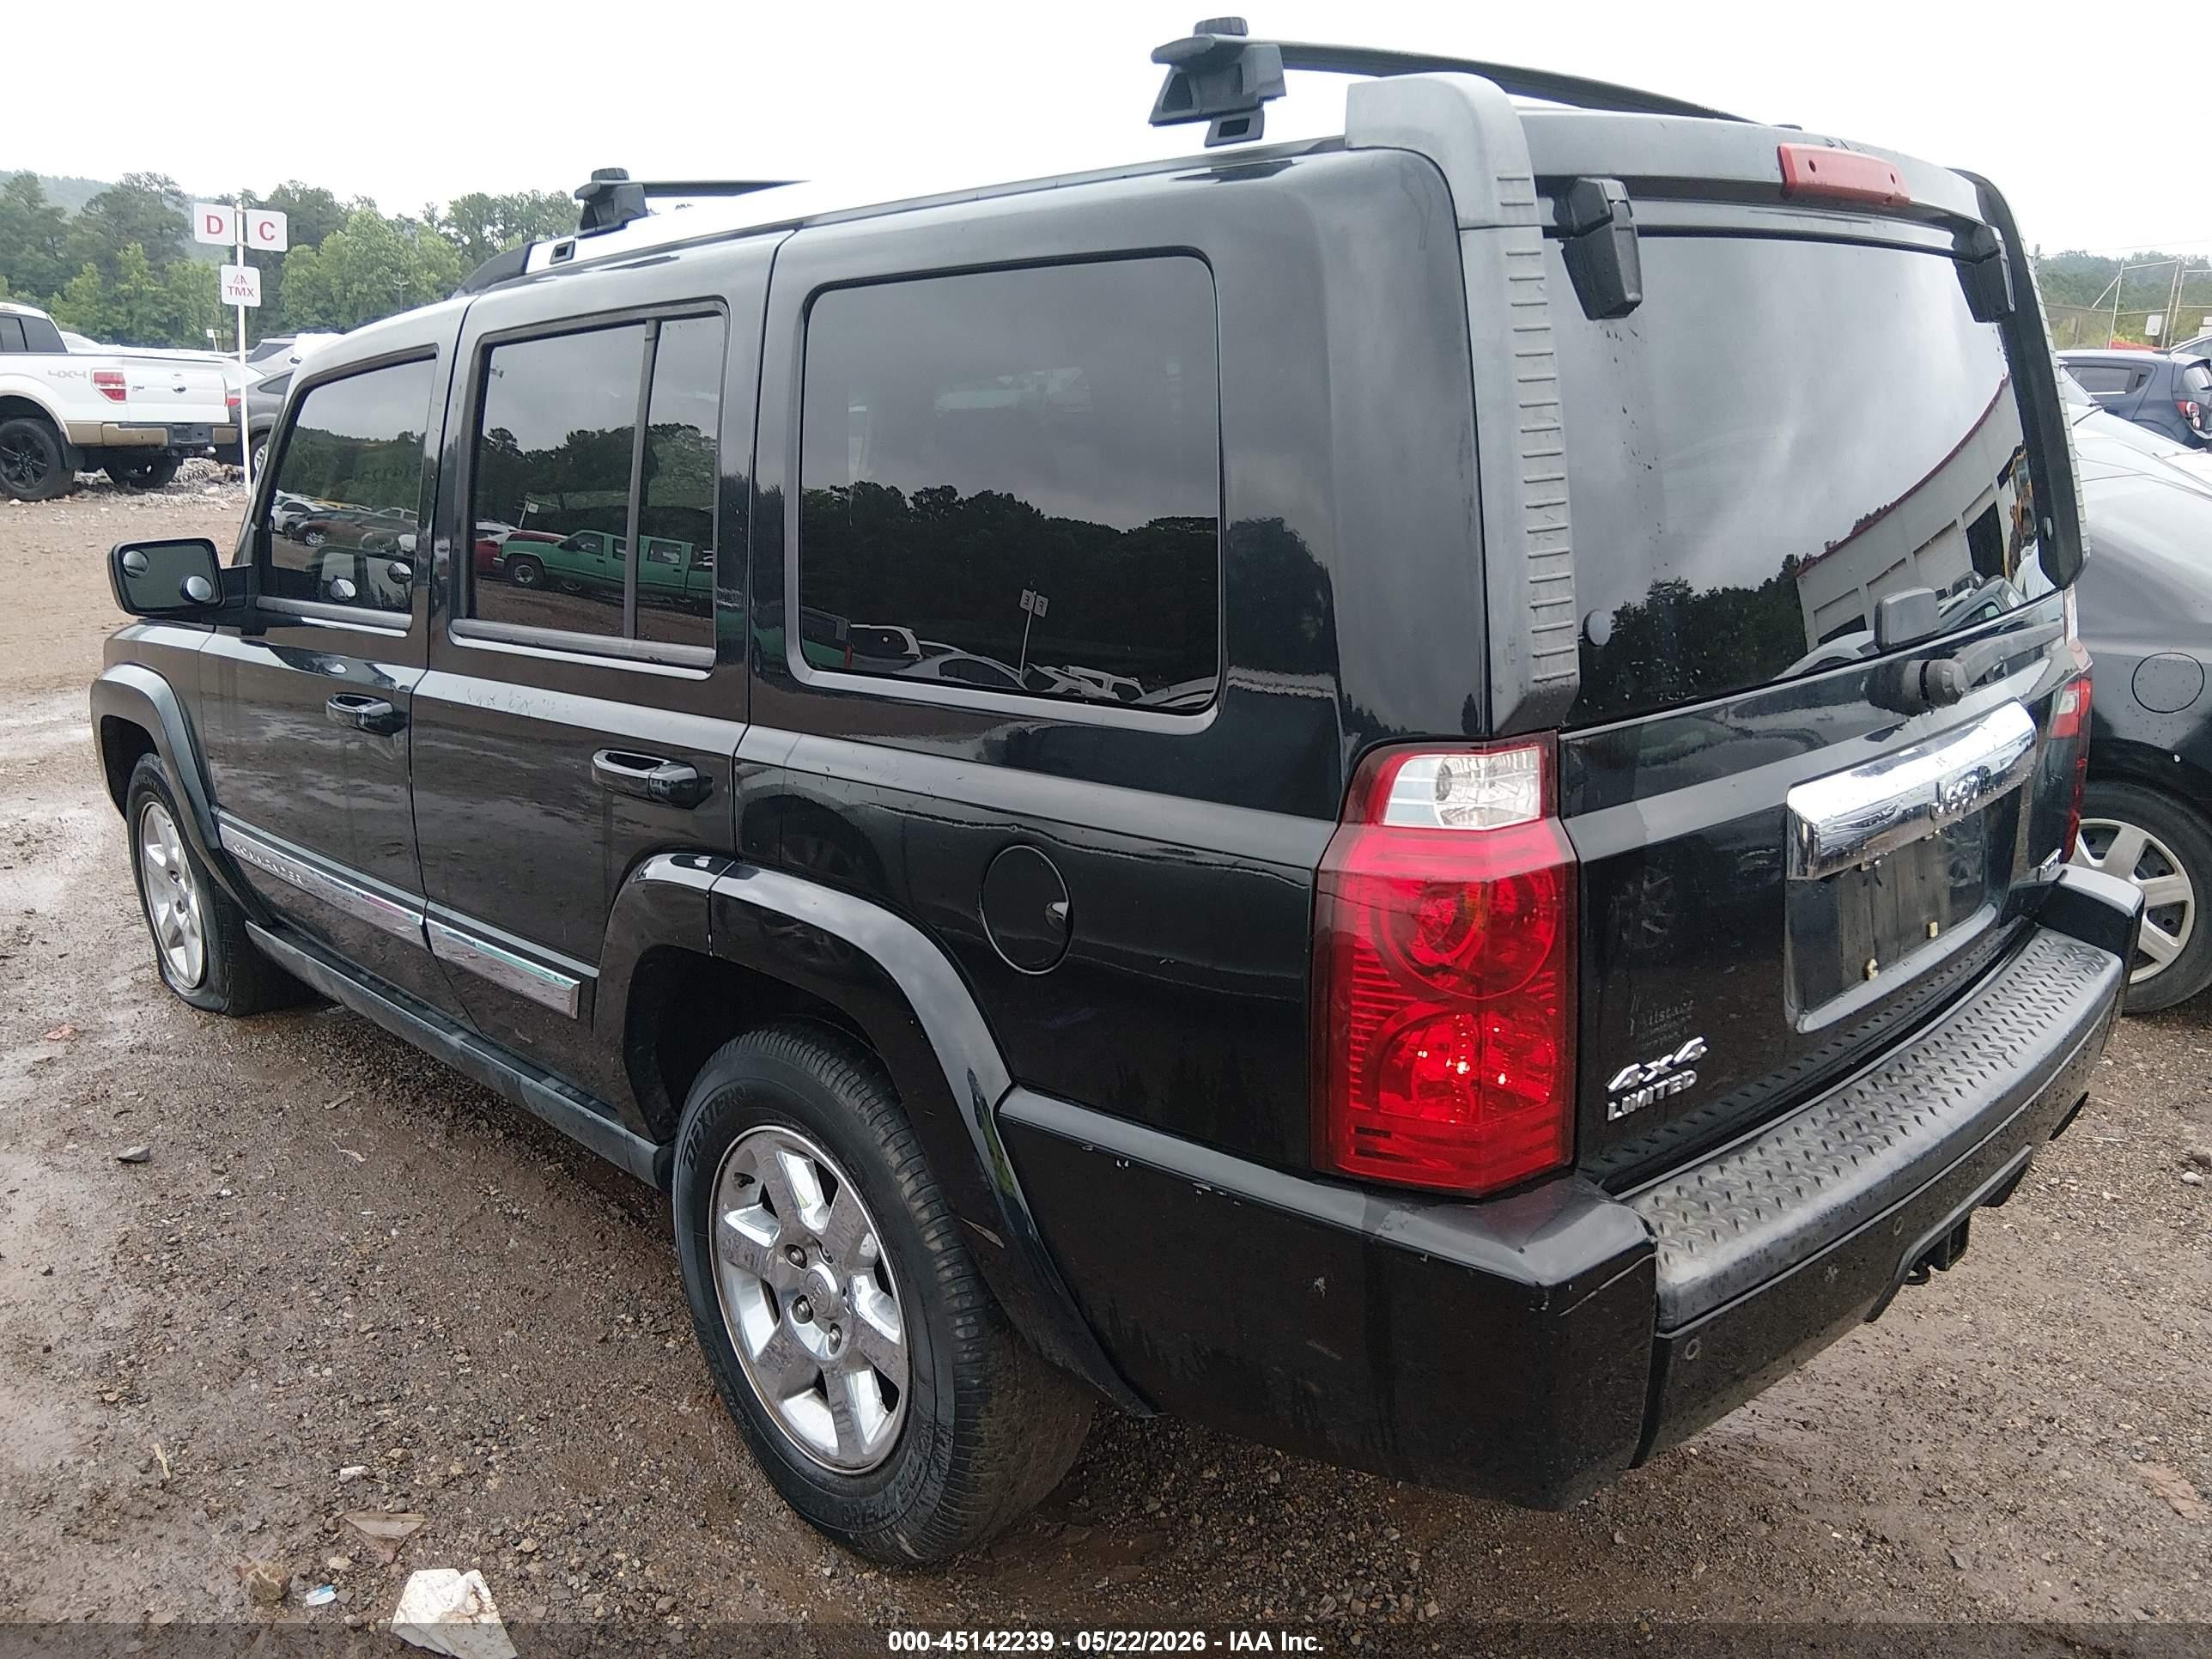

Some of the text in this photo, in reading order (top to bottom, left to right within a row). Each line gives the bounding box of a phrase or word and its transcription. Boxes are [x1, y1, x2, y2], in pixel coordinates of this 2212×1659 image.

[206, 215, 223, 234] D
[258, 221, 276, 241] C
[227, 285, 255, 298] TMX
[1607, 1069, 1698, 1121] LIMITED
